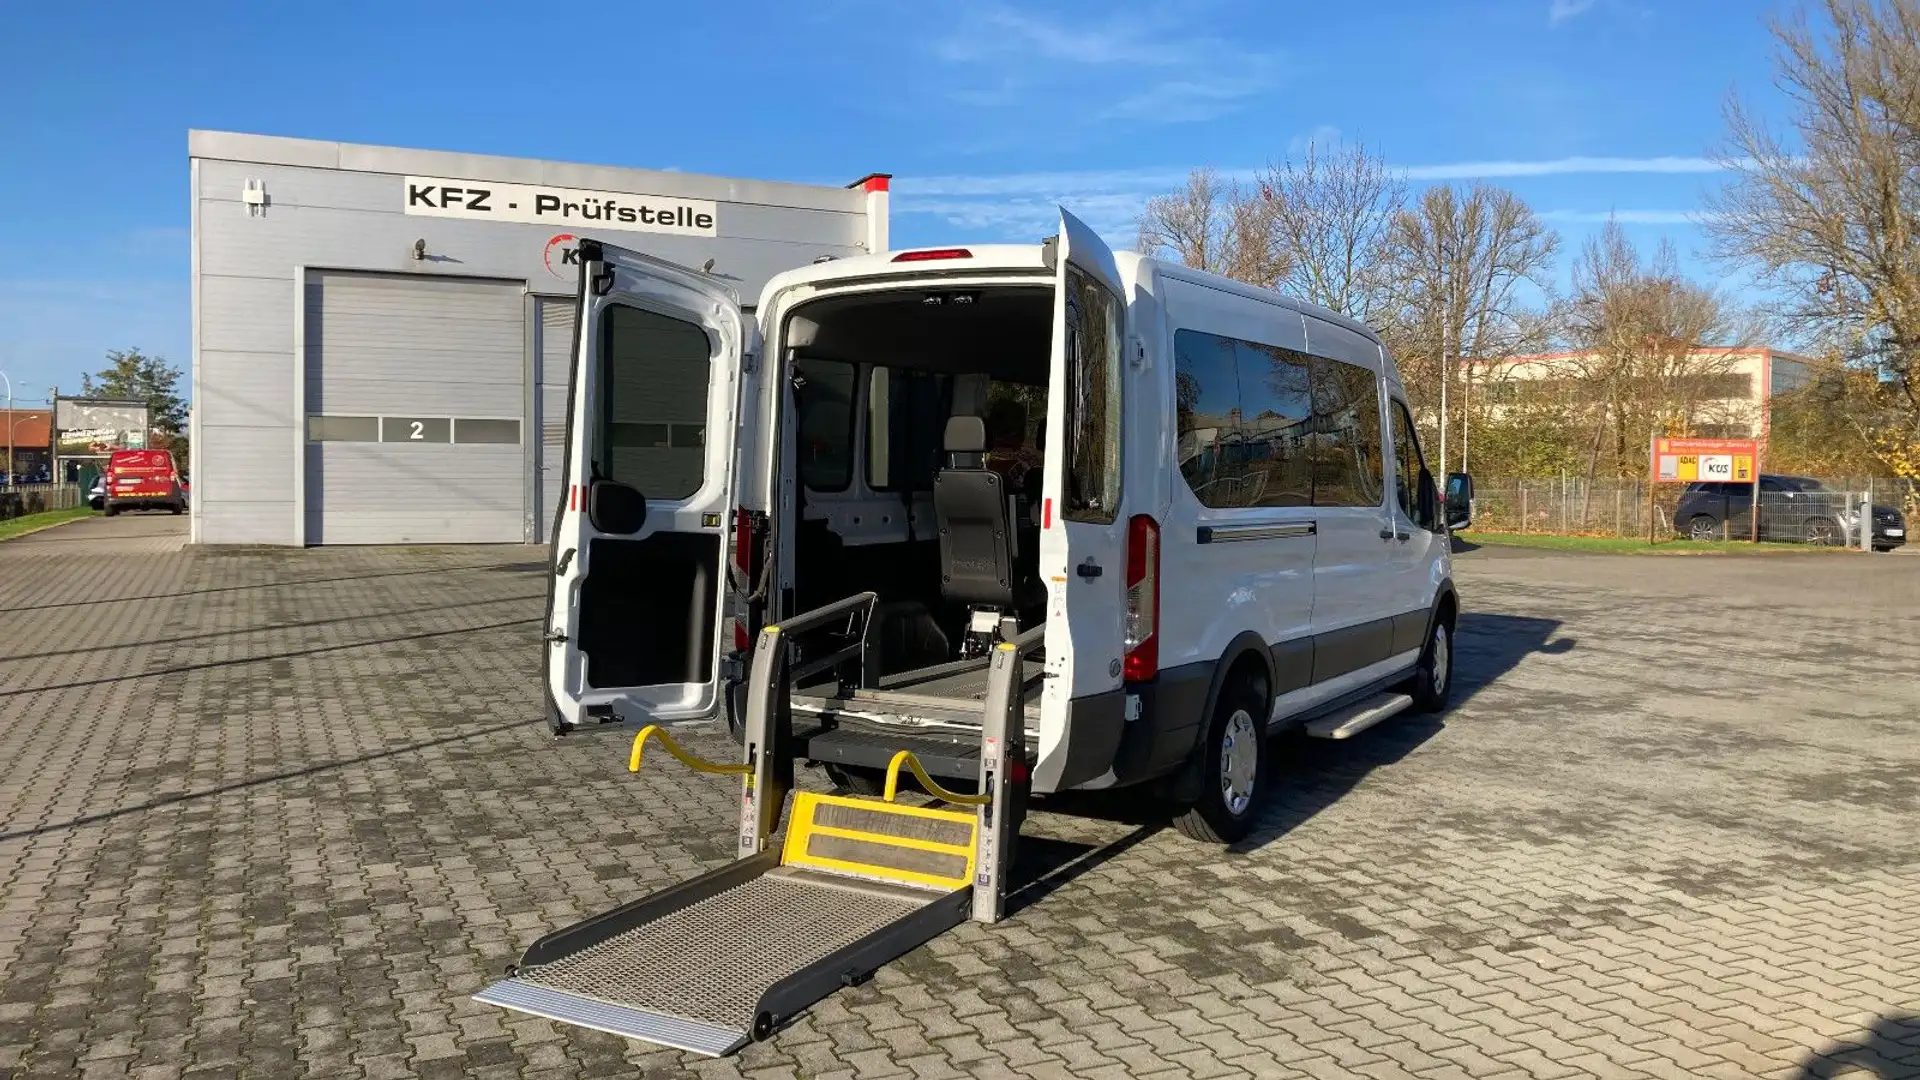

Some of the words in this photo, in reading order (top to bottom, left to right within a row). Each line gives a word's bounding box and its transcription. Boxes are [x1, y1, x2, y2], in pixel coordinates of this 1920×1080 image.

[409, 184, 491, 211] KFZ
[535, 194, 713, 229] Prüfstelle
[561, 248, 580, 265] K
[410, 421, 424, 440] 2
